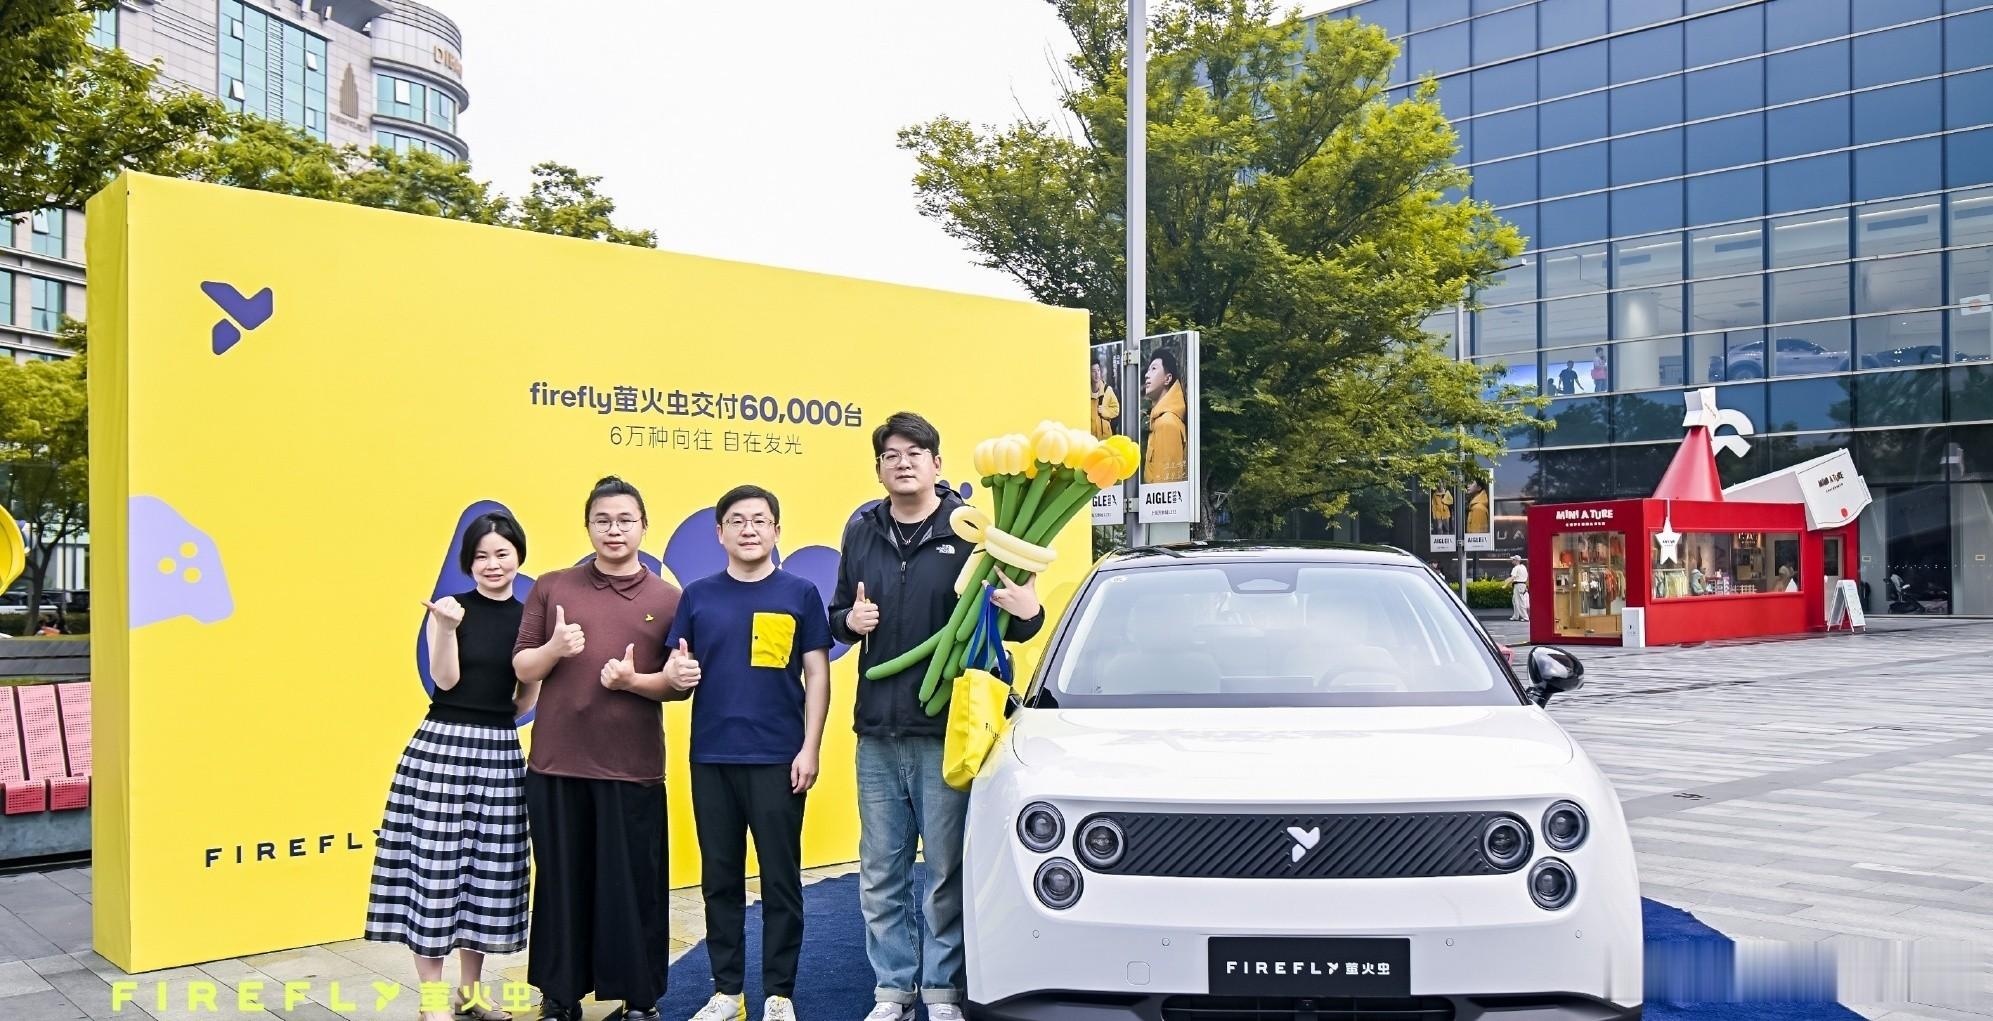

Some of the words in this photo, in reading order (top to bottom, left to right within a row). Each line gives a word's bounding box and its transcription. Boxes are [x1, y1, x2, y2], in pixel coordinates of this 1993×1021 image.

[529, 382, 862, 427] firefly萤火虫交付60,000台
[610, 425, 713, 450] 6万种向往
[724, 430, 803, 455] 自在发光
[1092, 495, 1107, 507] GLE
[1145, 491, 1172, 505] AIGLE
[205, 829, 381, 868] FIREFL
[1345, 962, 1391, 975] 萤火虫
